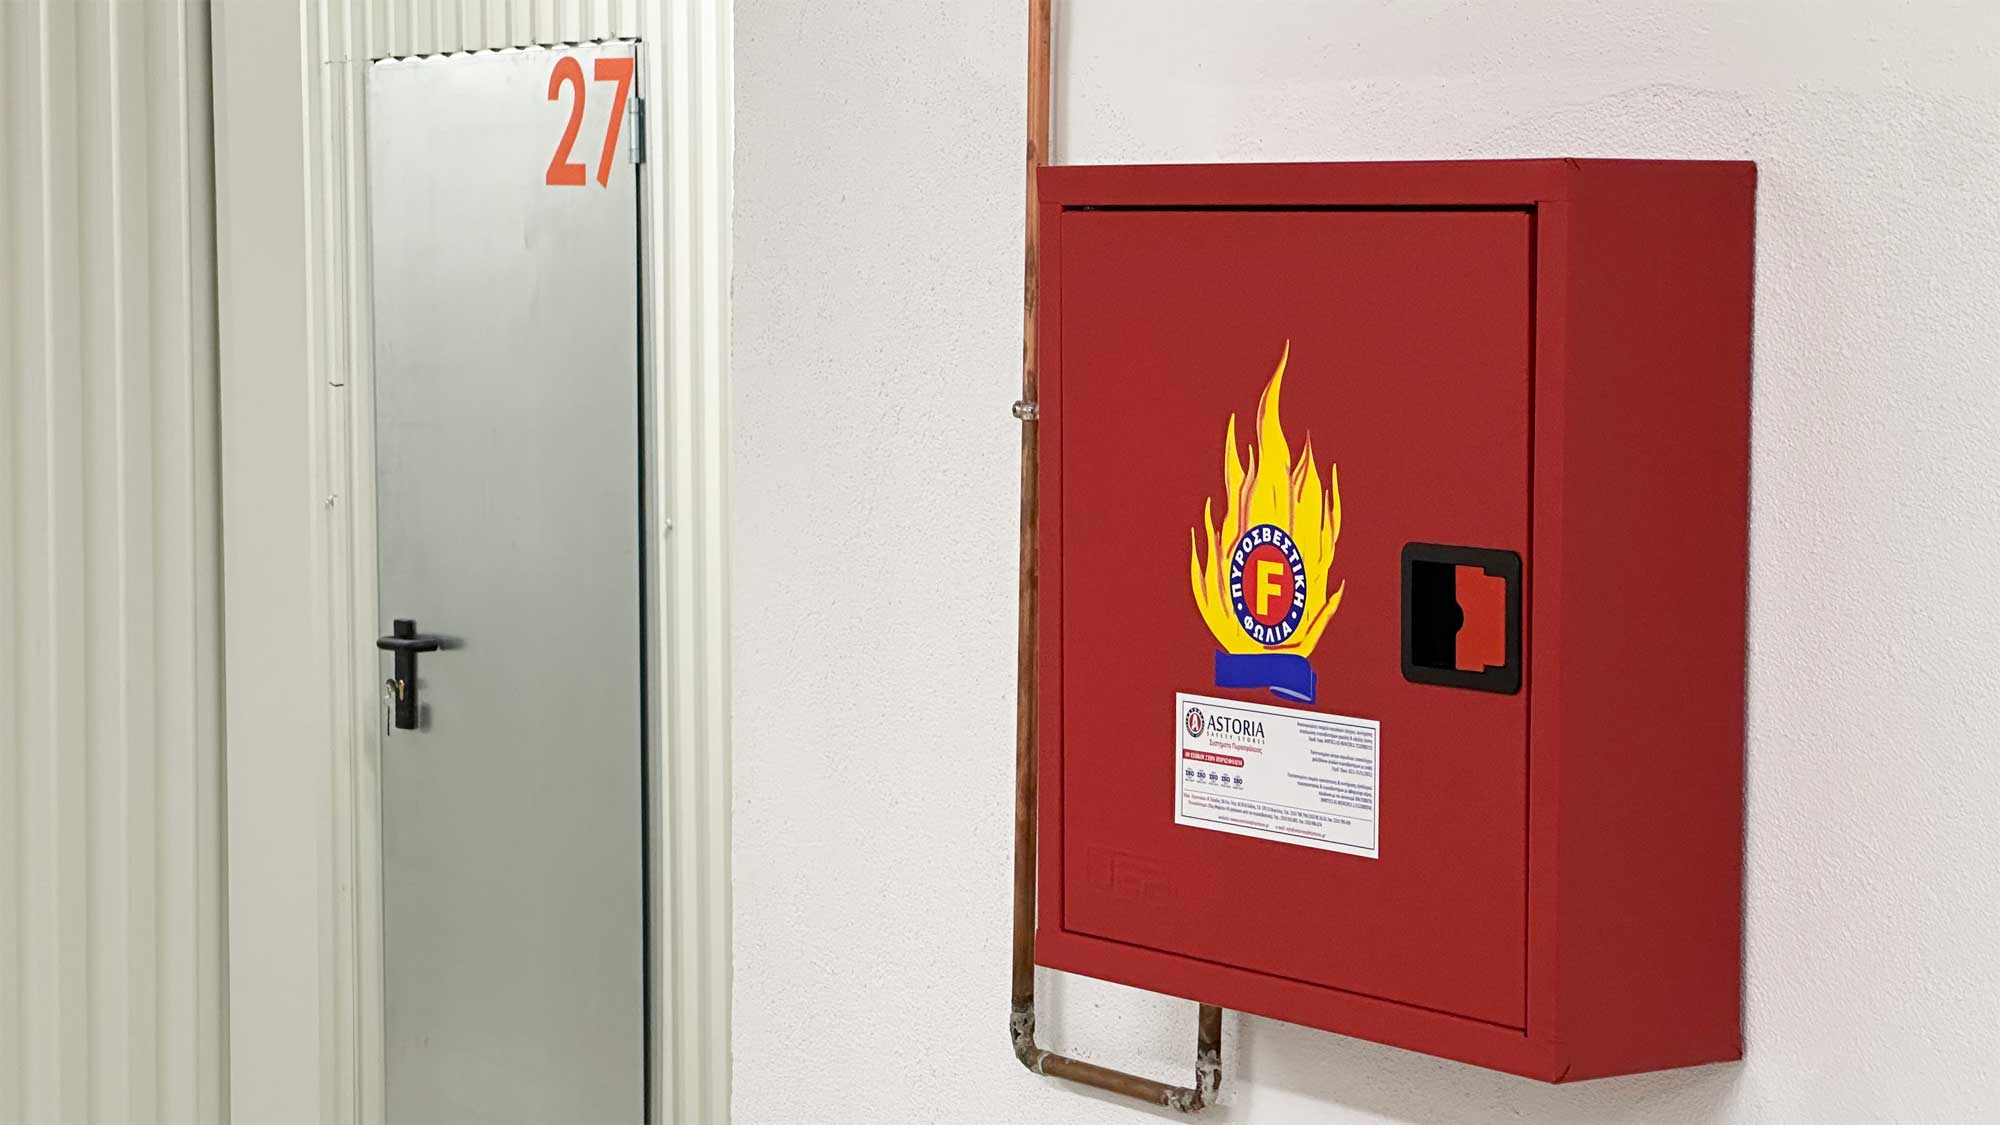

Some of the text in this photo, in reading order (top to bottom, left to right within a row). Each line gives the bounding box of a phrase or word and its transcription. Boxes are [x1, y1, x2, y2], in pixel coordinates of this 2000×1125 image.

[546, 56, 634, 189] 27
[1231, 527, 1305, 608] ΠΥΡΟΣΒΕΣΤΙΚΗ
[1256, 559, 1284, 616] F
[1243, 615, 1292, 643] ΦΩΛΙΑ
[1207, 715, 1265, 738] ASTORIA
[1207, 731, 1232, 739] SAFETY
